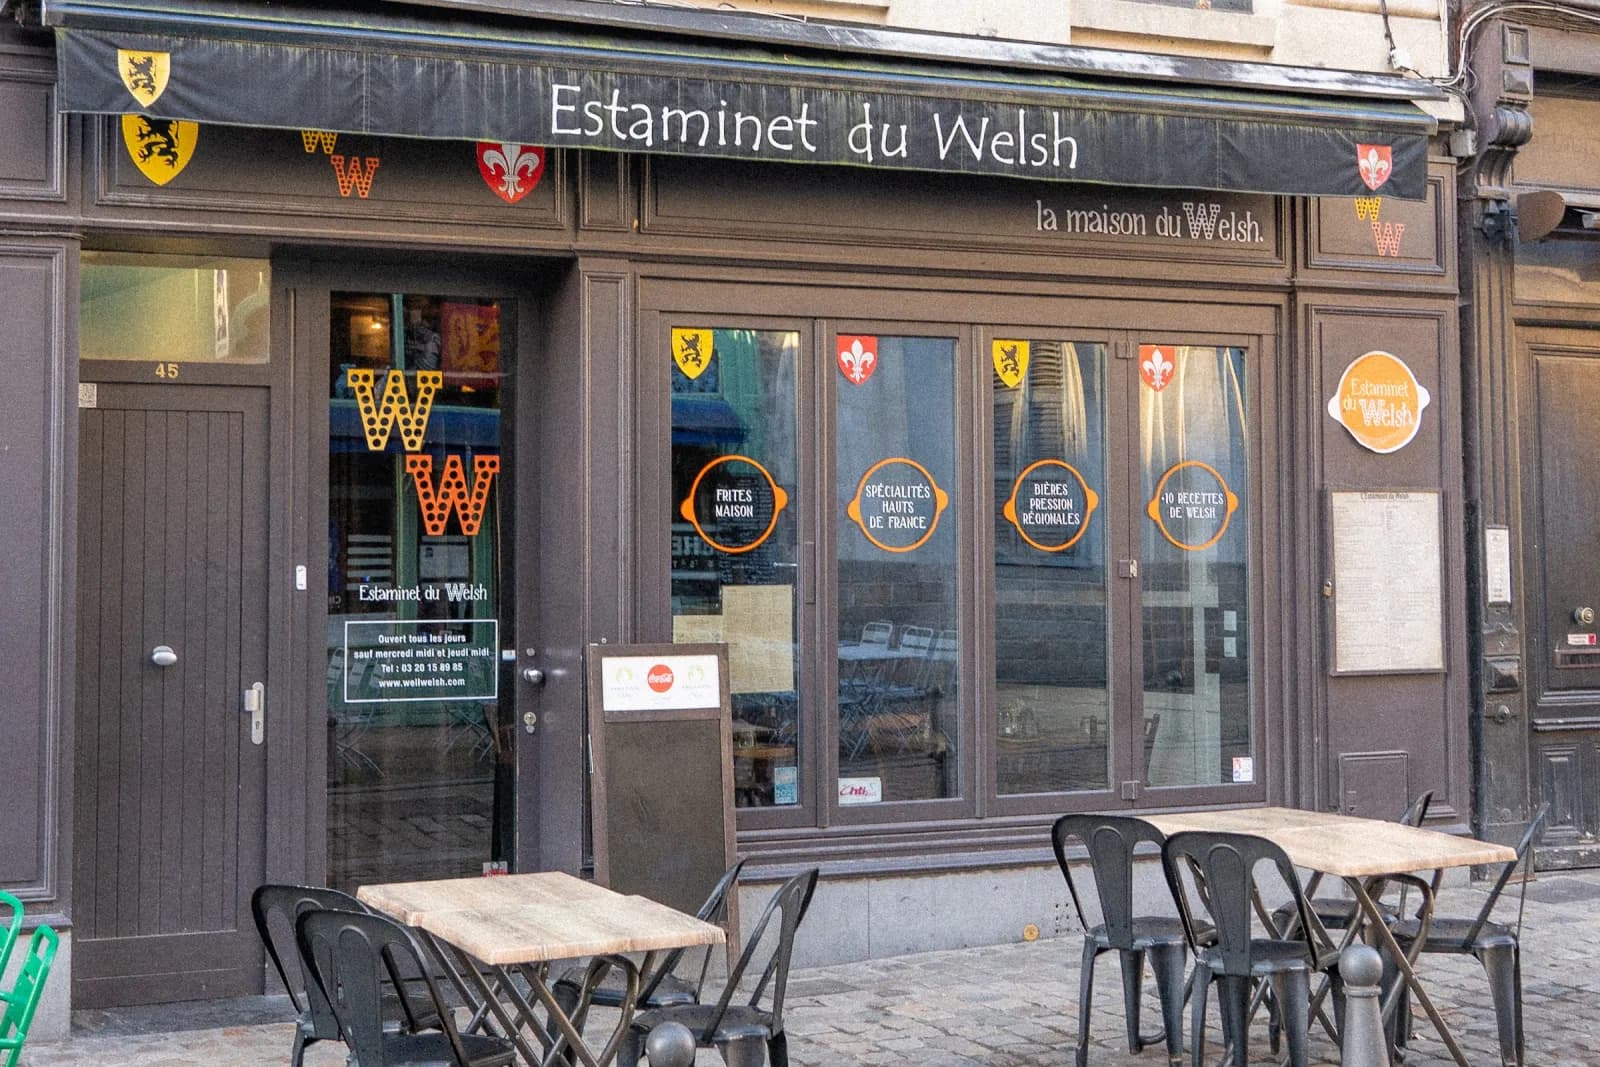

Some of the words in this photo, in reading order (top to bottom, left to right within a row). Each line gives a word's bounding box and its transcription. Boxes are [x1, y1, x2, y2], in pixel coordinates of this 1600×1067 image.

[551, 84, 818, 153] Estaminet
[848, 102, 907, 163] du
[933, 108, 1078, 169] Welsh
[331, 155, 379, 198] W
[1036, 200, 1058, 231] la
[1066, 204, 1146, 235] maison
[1156, 206, 1181, 238] du
[1183, 202, 1264, 242] Welsh.
[1371, 222, 1405, 256] W
[155, 362, 179, 379] 45
[1351, 378, 1409, 397] Estaminet
[1343, 393, 1357, 411] du
[347, 369, 443, 451] W
[406, 455, 500, 536] W
[716, 489, 753, 502] FRITES
[865, 483, 931, 498] SPÉCIALITÉS
[1034, 482, 1068, 496] BIÈRES
[1030, 498, 1073, 511] PRESSION
[1178, 492, 1224, 505] RECETTES
[715, 505, 754, 518] MAISON
[882, 501, 914, 513] HAUTS
[1169, 507, 1183, 519] DE
[1187, 507, 1216, 519] WELSH
[869, 516, 884, 529] DE
[888, 516, 927, 529] FRANCE
[1023, 511, 1081, 525] RÉGIONALES
[359, 584, 421, 601] Estaminet
[425, 584, 440, 601] du
[445, 583, 488, 602] Welsh
[378, 634, 407, 644] Ouvert
[408, 634, 428, 643] tous
[430, 633, 443, 643] les
[444, 633, 466, 644] jours
[354, 649, 373, 659] sauf
[375, 648, 414, 658] mercredi
[416, 648, 435, 658] midi
[437, 648, 446, 657] et
[447, 647, 469, 659] jeudi
[471, 647, 490, 657] midi
[381, 663, 394, 673] Tel
[401, 663, 413, 673] 03
[414, 663, 425, 673] 20
[428, 663, 438, 672] 15
[439, 663, 451, 672] 89
[452, 662, 463, 672] 85
[378, 677, 466, 688] www.wellwelsh.com
